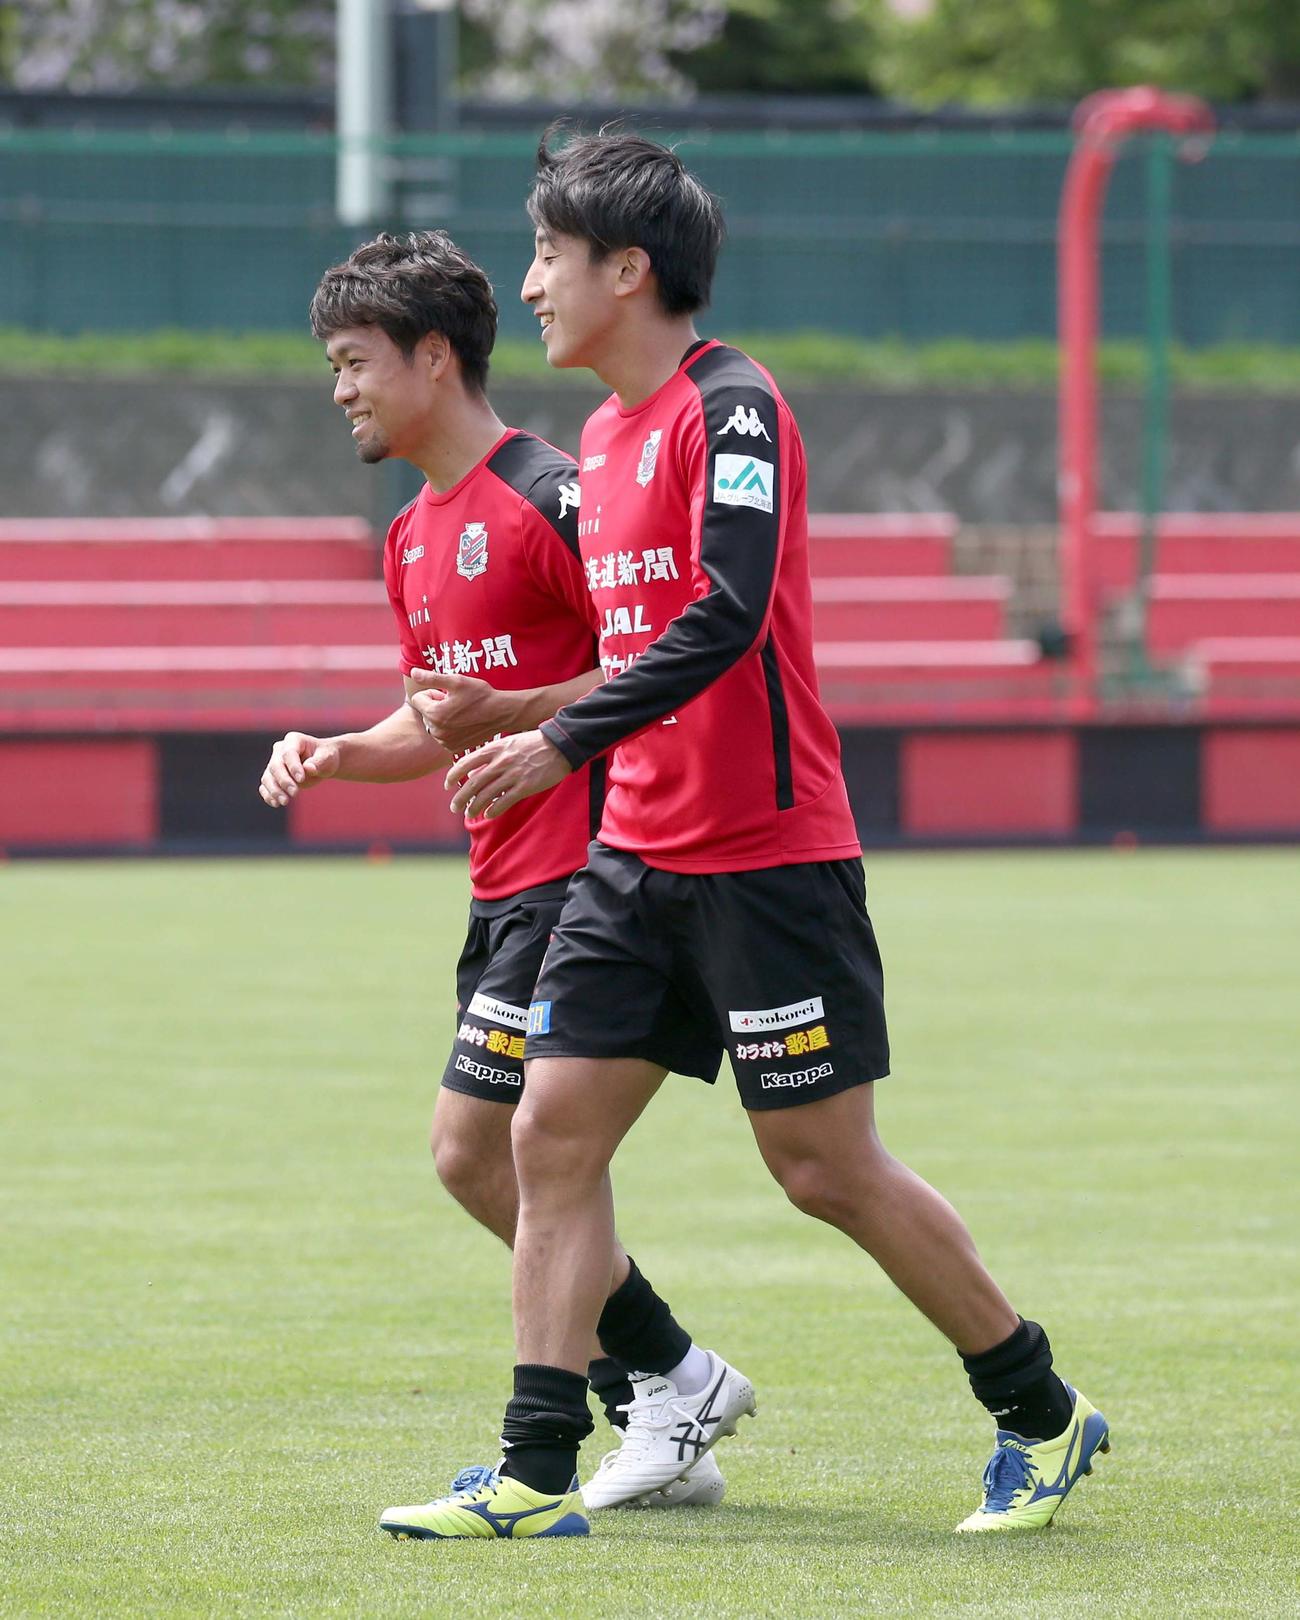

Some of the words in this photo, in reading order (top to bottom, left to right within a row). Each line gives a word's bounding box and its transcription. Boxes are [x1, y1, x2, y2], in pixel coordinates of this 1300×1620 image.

[601, 605, 652, 642] JAL
[758, 1002, 814, 1026] yokorei
[736, 1025, 830, 1060] カラオケ歌屋
[455, 1054, 521, 1086] Kappa
[761, 1062, 834, 1089] Kappa
